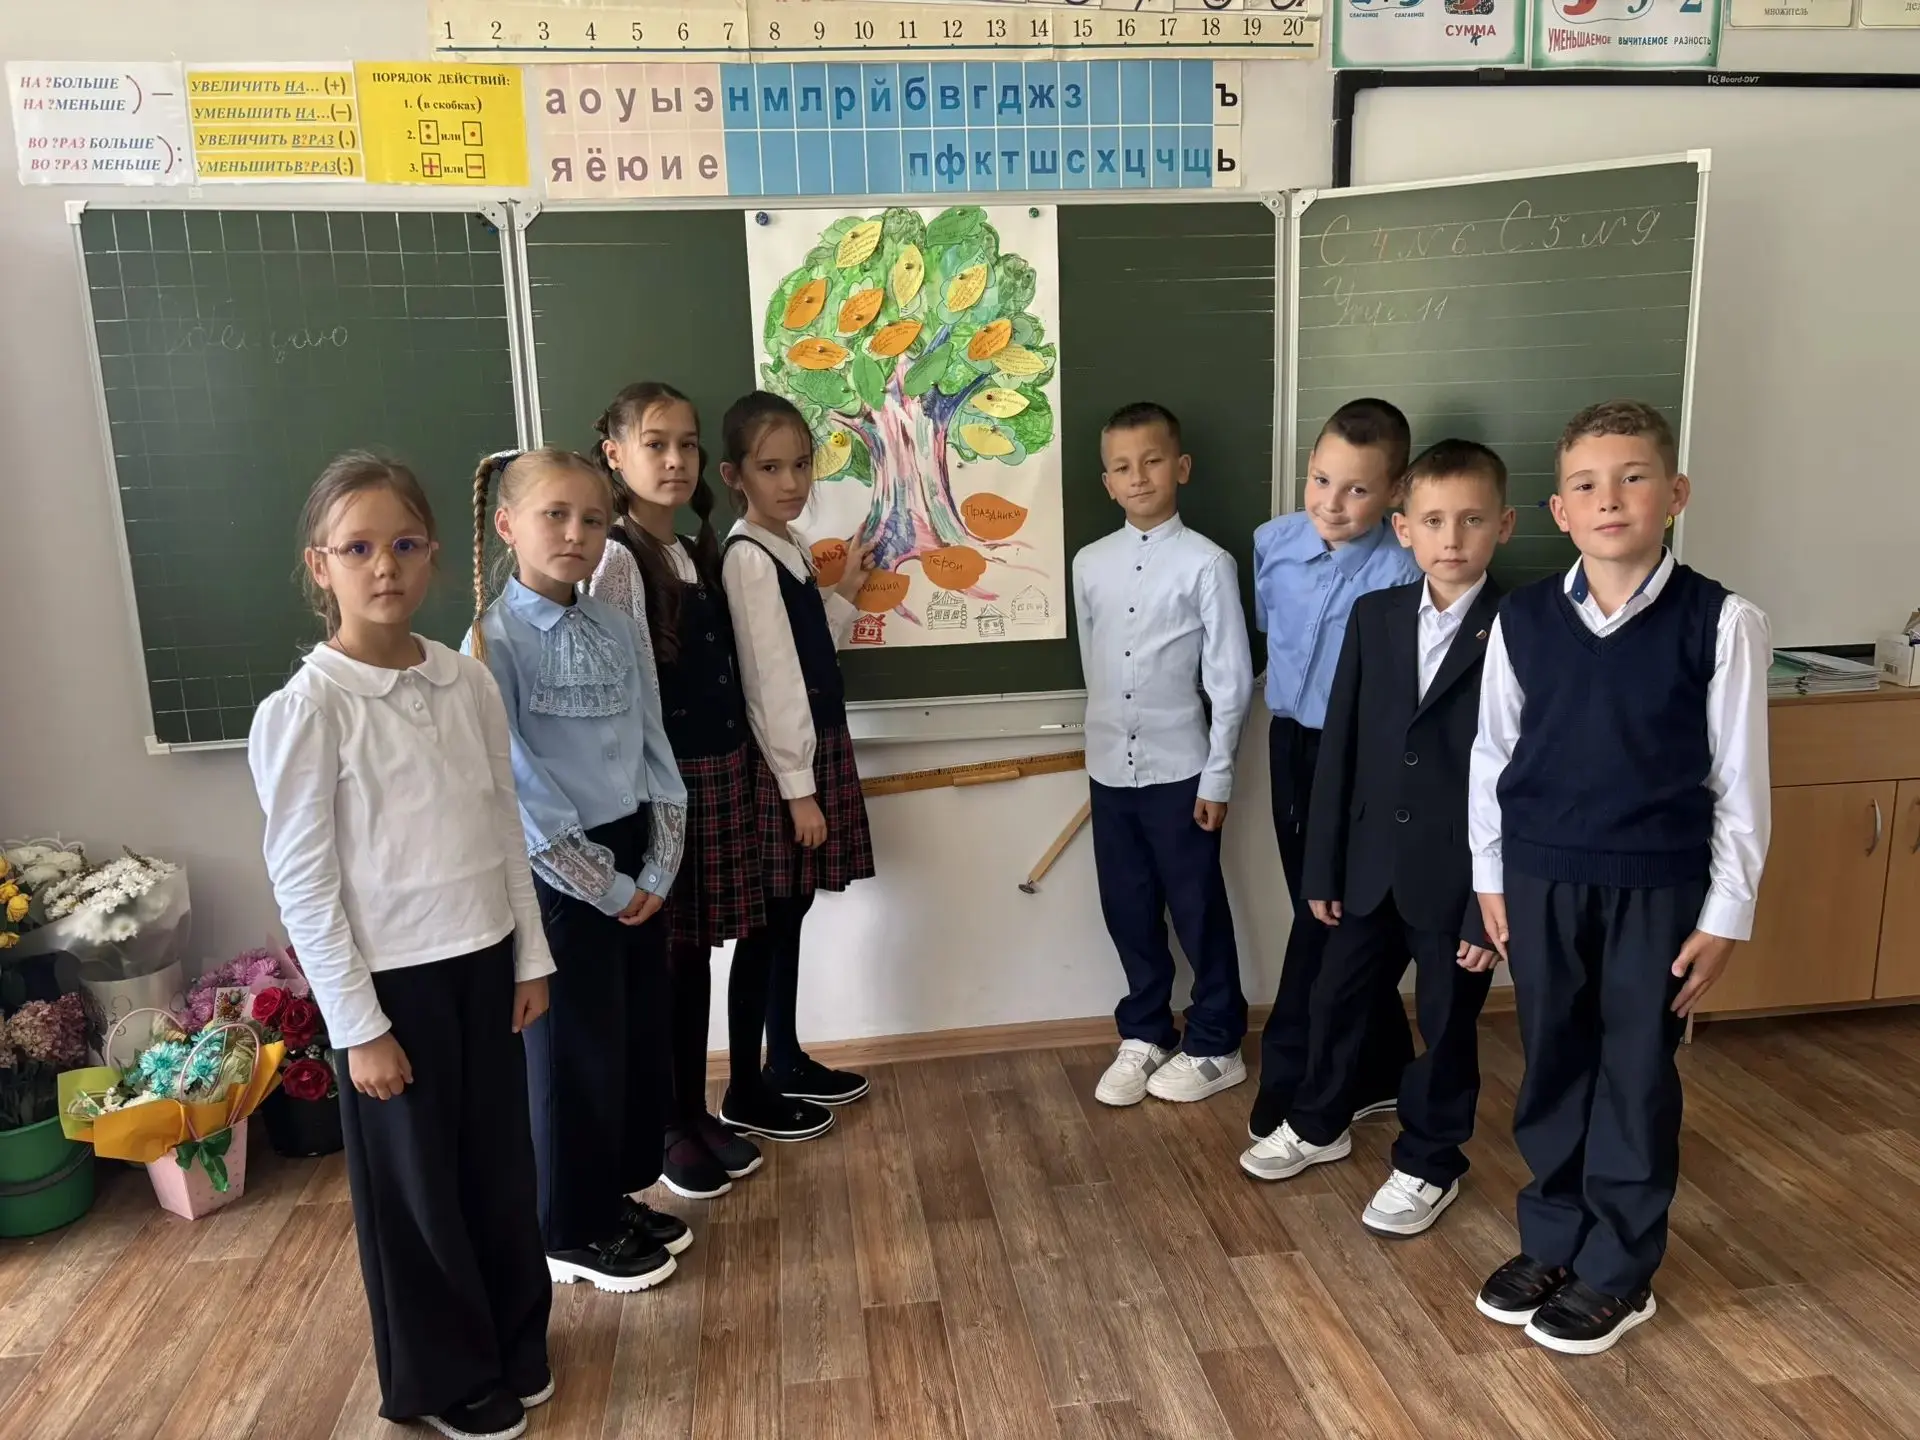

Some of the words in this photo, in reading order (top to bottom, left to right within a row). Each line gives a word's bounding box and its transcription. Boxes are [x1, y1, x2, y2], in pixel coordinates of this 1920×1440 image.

[444, 21, 454, 40] 1
[491, 21, 501, 40] 2
[538, 22, 549, 41] 3
[585, 22, 597, 41] 4
[632, 22, 643, 41] 5
[678, 22, 689, 41] 6
[723, 22, 734, 41] 7
[770, 22, 781, 40] 8
[814, 21, 825, 40] 9
[855, 20, 874, 39] 10
[899, 20, 918, 39] 11
[942, 20, 963, 38] 12
[986, 19, 1007, 38] 13
[1030, 19, 1049, 37] 14
[1073, 19, 1093, 37] 15
[1116, 18, 1135, 37] 16
[1159, 18, 1177, 36] 17
[1202, 18, 1220, 36] 18
[1243, 18, 1262, 36] 19
[1283, 18, 1304, 36] 20
[1445, 24, 1497, 37] СУММА
[1548, 27, 1612, 53] УМЕНЬШАЕМОЕ
[1618, 36, 1668, 46] ВЫЧИТАЕМОЕ
[1673, 36, 1712, 46] РАЗНОСТЬ
[20, 77, 41, 89] НА
[372, 72, 432, 84] ПОРЯДОК
[437, 72, 510, 86] ДЕЙСТВИЙ:
[191, 80, 281, 93] УВЕЛИЧИТЬ
[23, 98, 44, 110] НА
[404, 99, 413, 109] 1.
[546, 88, 568, 115] а
[579, 88, 601, 114] о
[618, 88, 637, 123] у
[652, 87, 682, 113] ы
[694, 86, 714, 112] э
[729, 87, 749, 112] н
[763, 87, 790, 112] м
[799, 87, 823, 112] л
[836, 85, 856, 119] р
[872, 78, 892, 112] й
[905, 76, 927, 111] б
[940, 85, 960, 110] в
[973, 85, 988, 109] г
[997, 85, 1022, 115] д
[1028, 84, 1055, 109] ж
[1064, 84, 1083, 109] з
[195, 107, 292, 120] УМЕНЬШИТЬ
[199, 134, 288, 146] УВЕЛИЧИТЬ
[407, 130, 416, 140] 2.
[440, 133, 461, 142] или
[28, 137, 48, 149] ВО
[89, 137, 155, 150] БОЛЬШЕ
[31, 159, 50, 170] ВО
[91, 159, 161, 171] МЕНЬШЕ
[409, 163, 418, 173] 3.
[443, 165, 464, 174] или
[551, 157, 573, 183] я
[585, 147, 607, 183] ё
[617, 156, 649, 182] ю
[661, 155, 683, 181] и
[698, 154, 719, 181] е
[909, 152, 929, 177] п
[934, 144, 966, 184] ф
[976, 151, 993, 176] к
[1001, 150, 1020, 175] т
[1029, 150, 1058, 174] ш
[1066, 150, 1086, 174] с
[1096, 150, 1117, 174] х
[1125, 149, 1146, 178] ц
[1155, 148, 1175, 173] ч
[1183, 148, 1213, 178] щ
[1543, 215, 1570, 249] 5
[1632, 208, 1661, 246] 9
[965, 504, 1021, 521] Праздники
[928, 554, 963, 573] Герои
